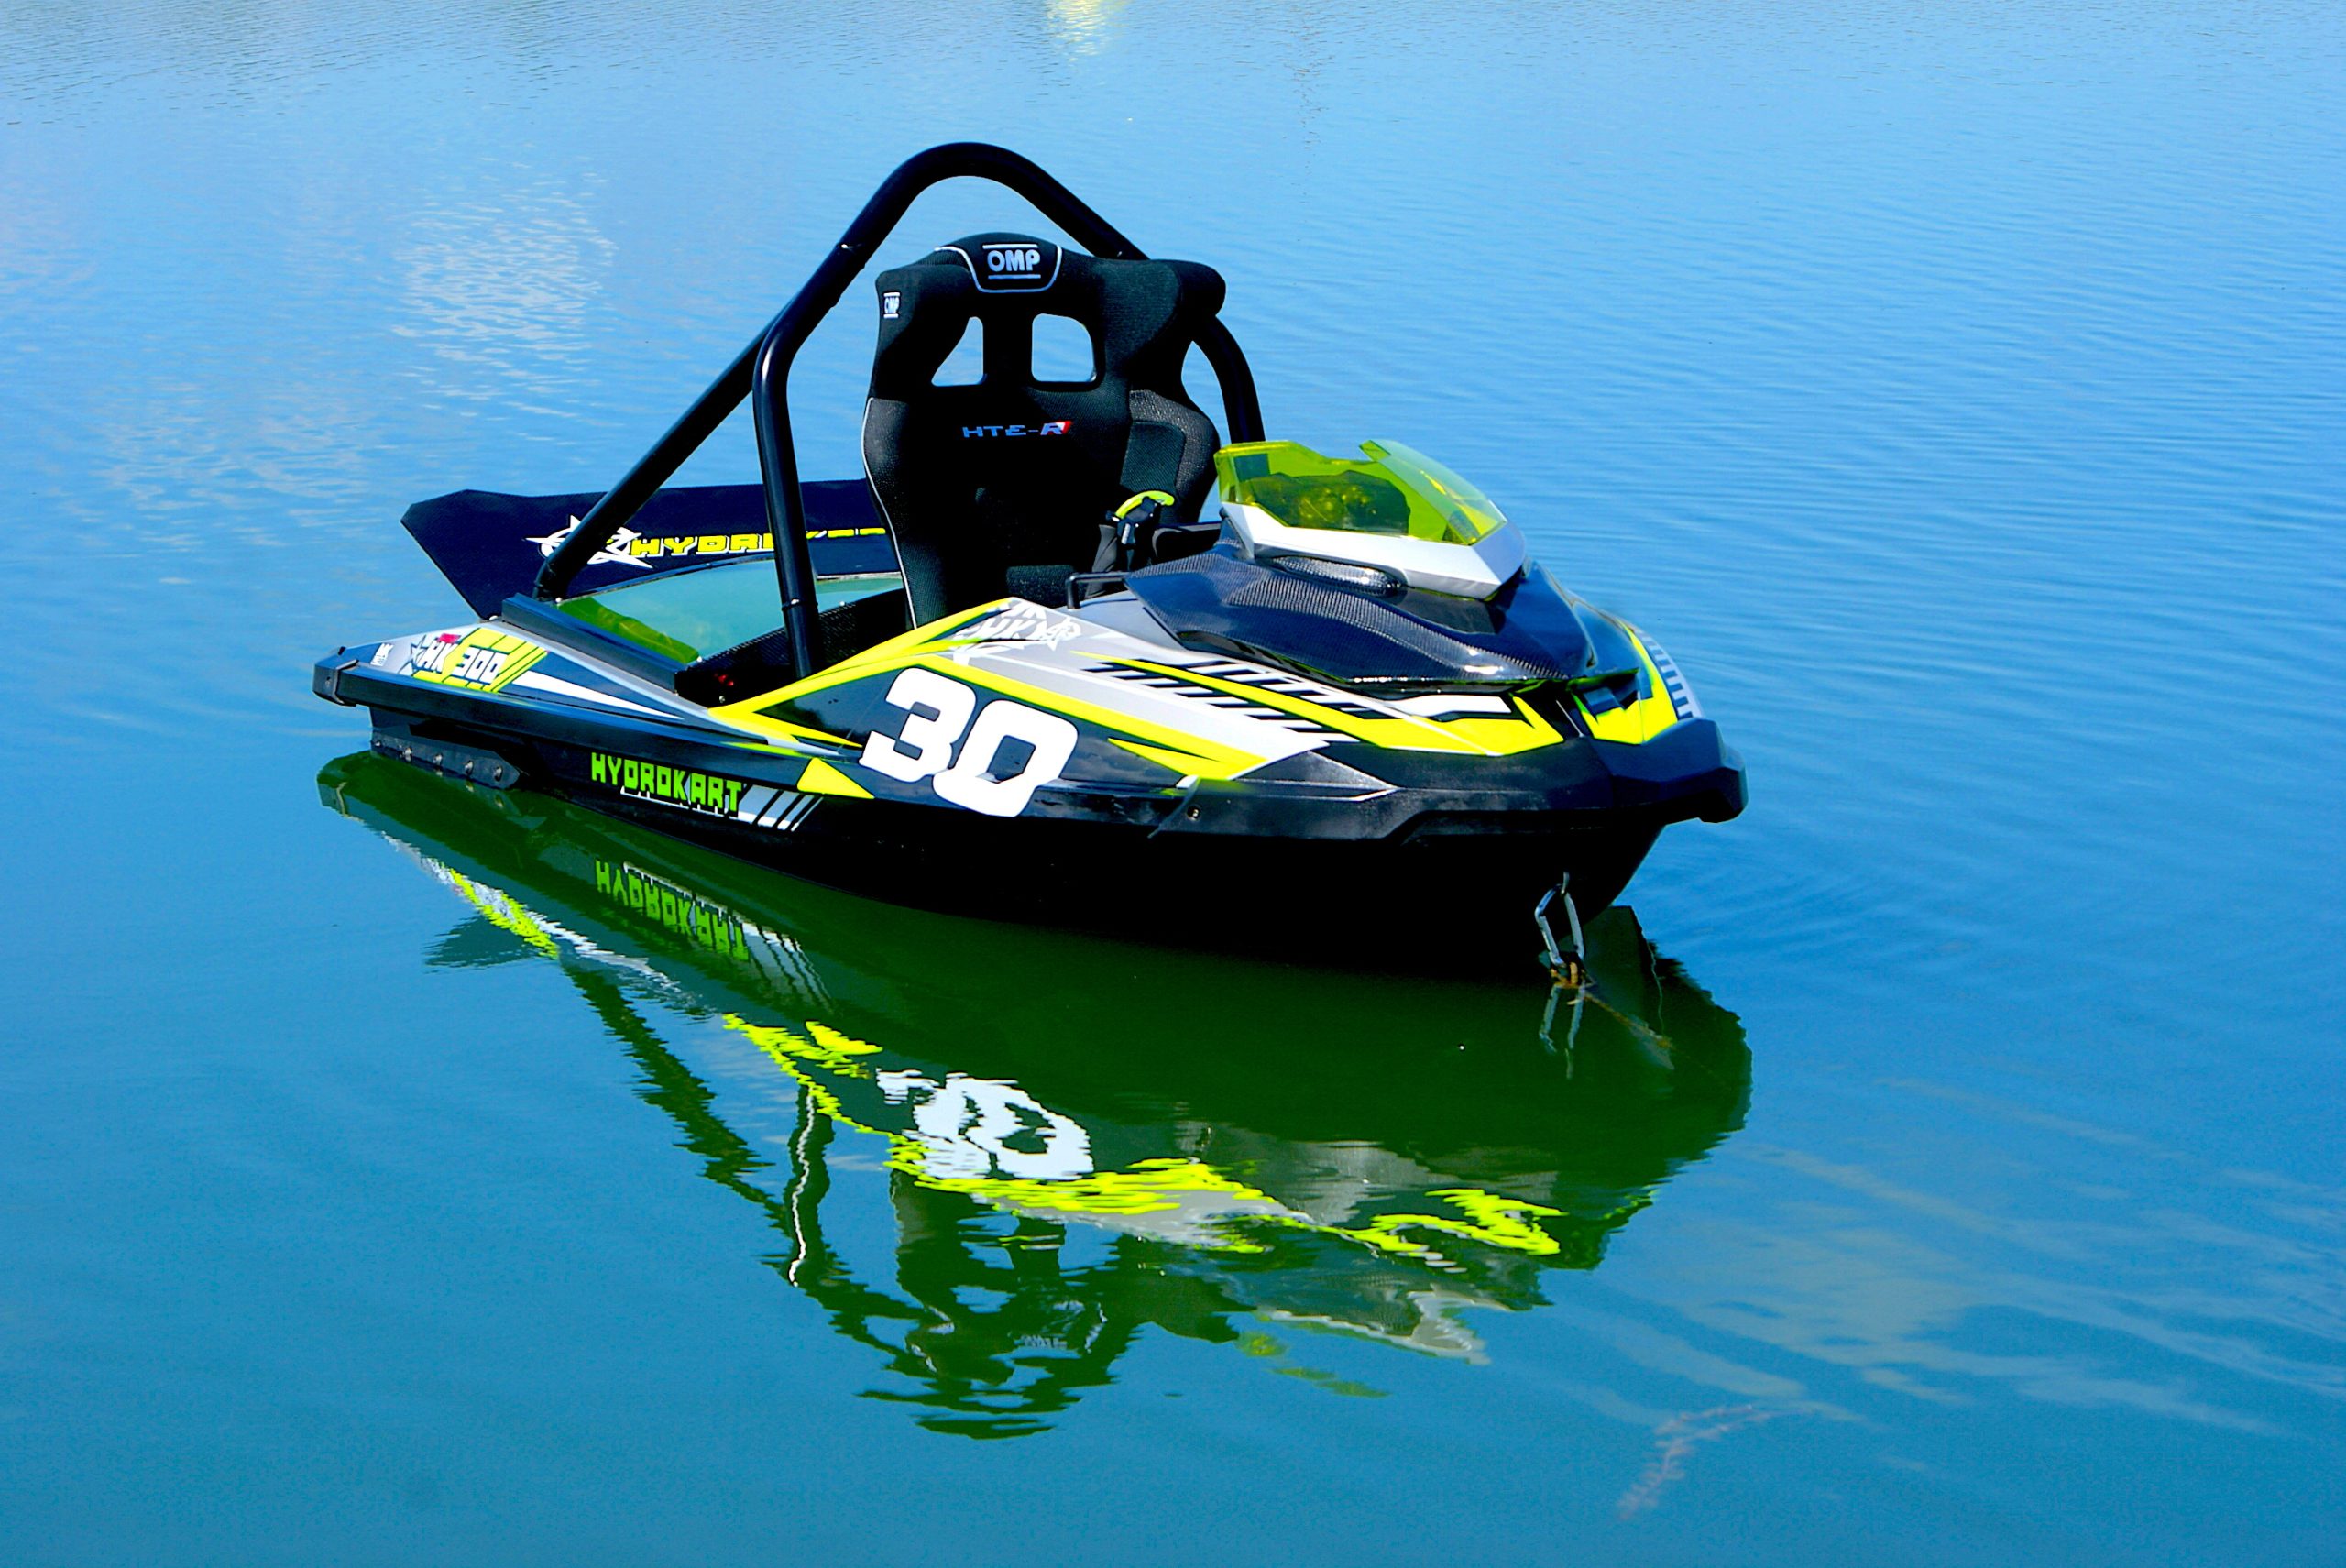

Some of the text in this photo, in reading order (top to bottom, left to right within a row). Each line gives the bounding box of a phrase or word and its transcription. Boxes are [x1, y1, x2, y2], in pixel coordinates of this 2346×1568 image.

[987, 249, 1041, 272] OMP
[962, 422, 1069, 438] HTE-R
[450, 644, 508, 685] 300
[859, 666, 1079, 818] 30
[591, 752, 741, 812] HYDROKART
